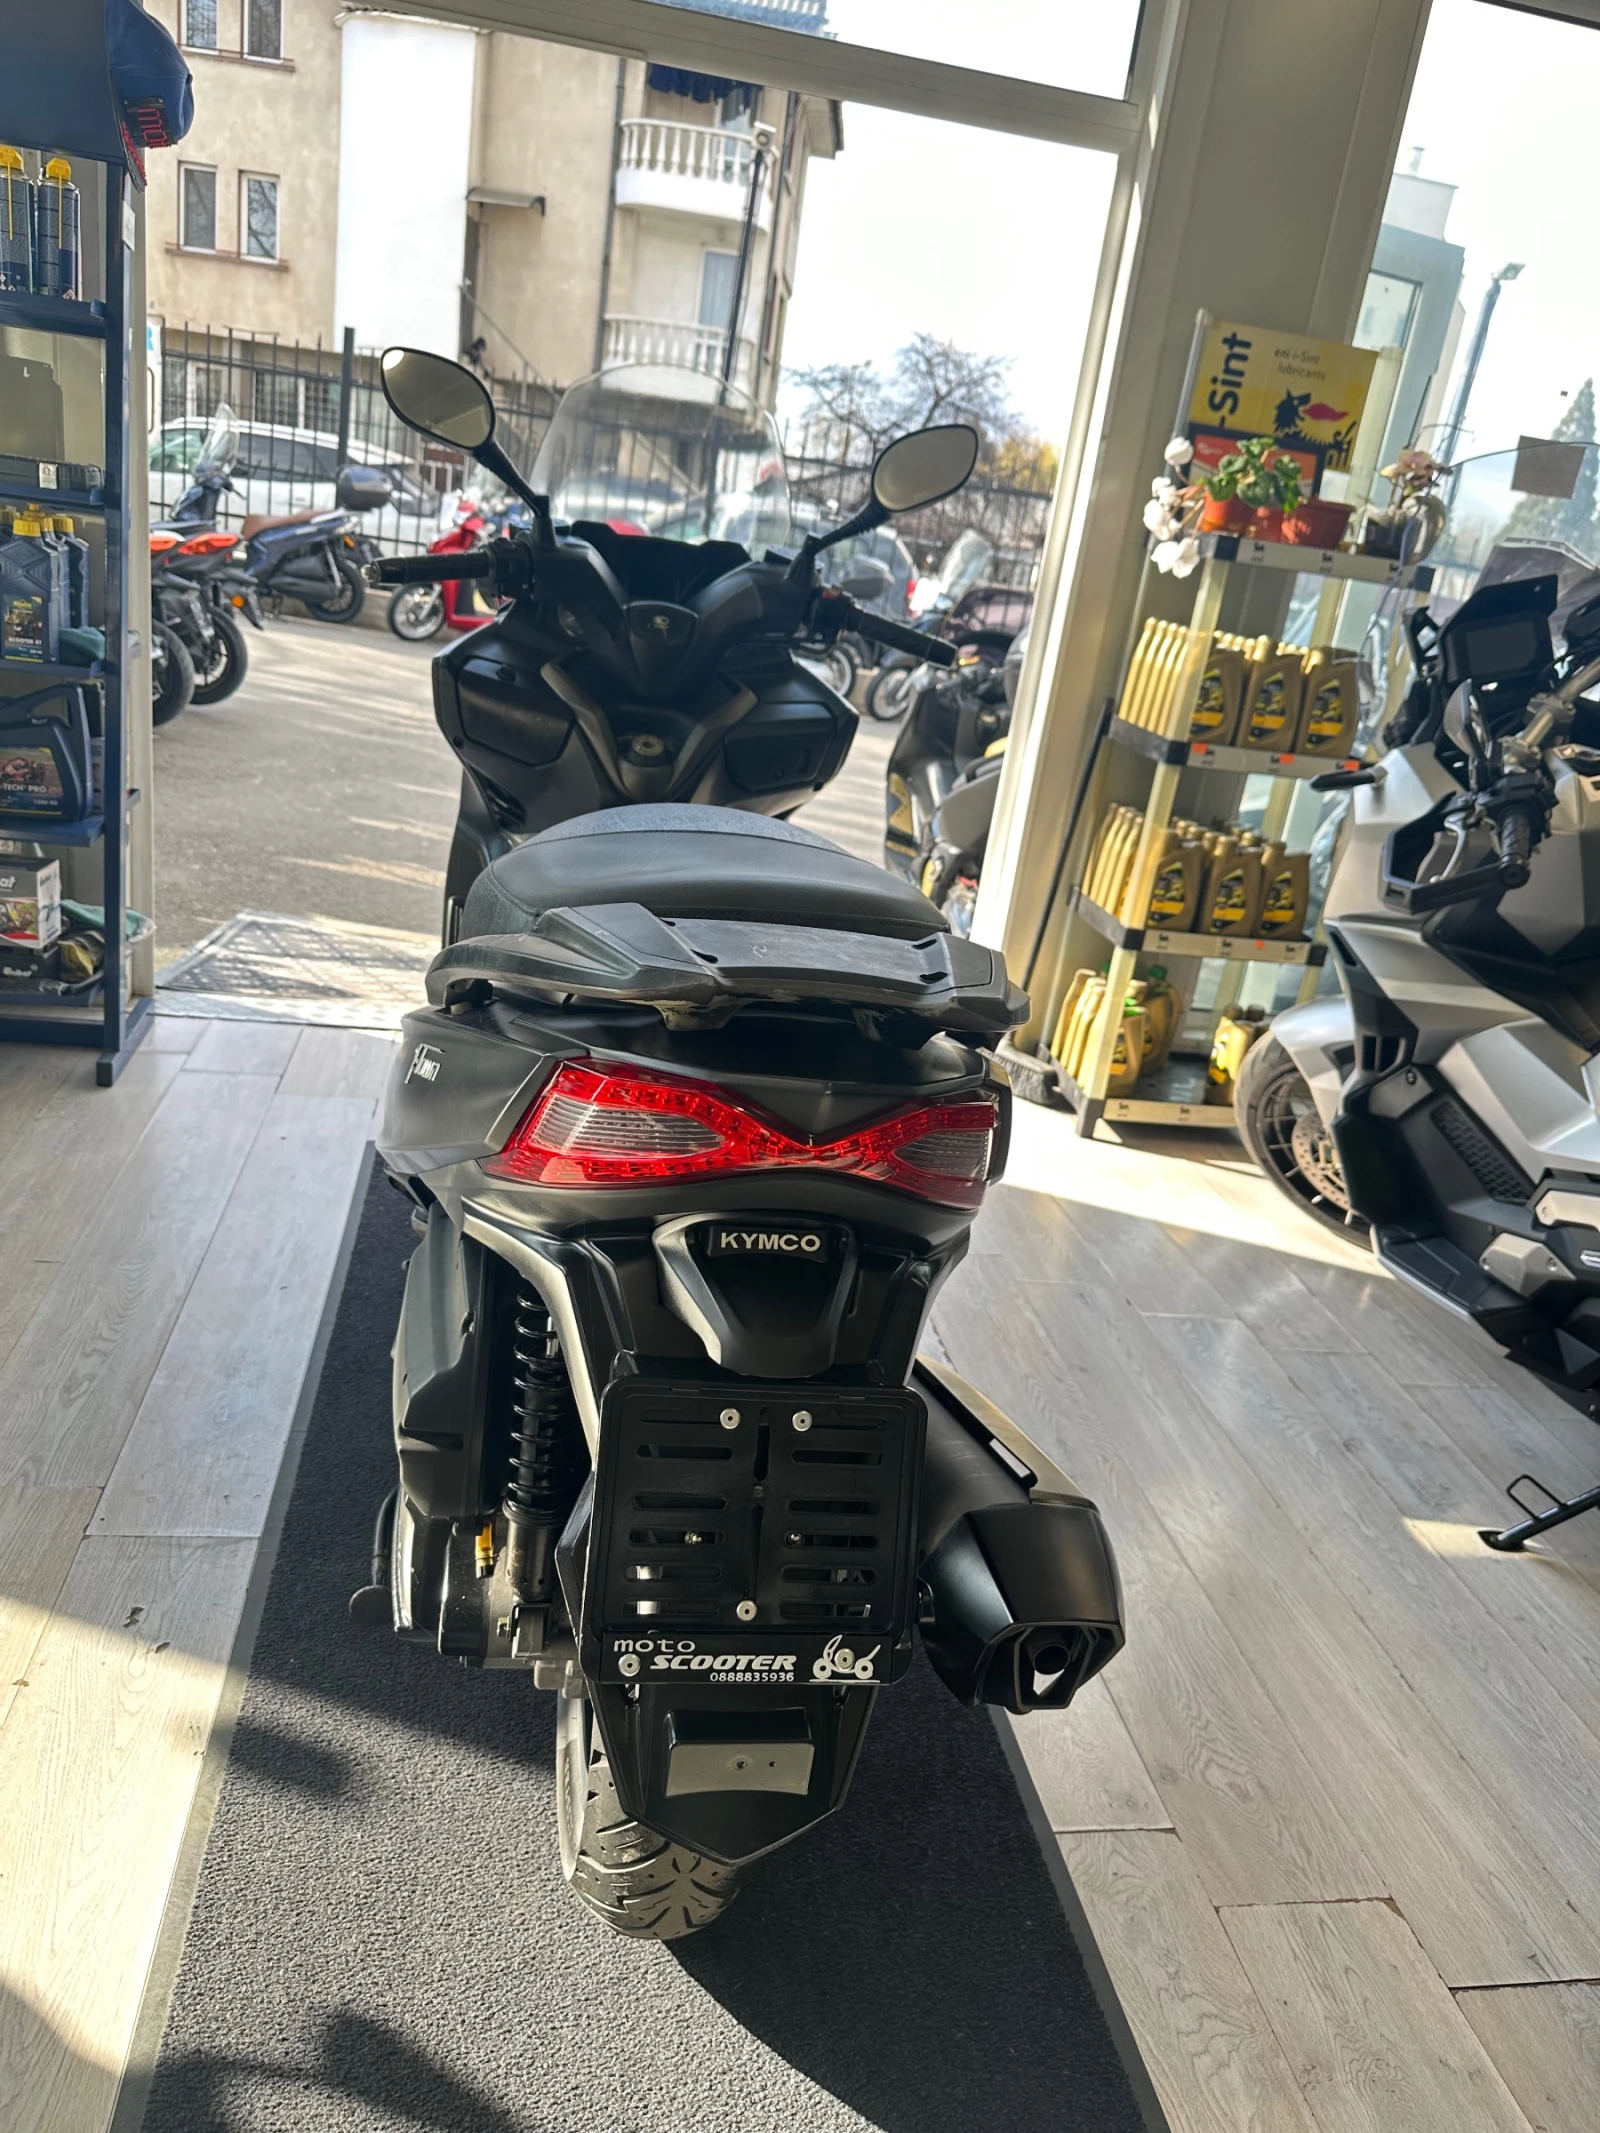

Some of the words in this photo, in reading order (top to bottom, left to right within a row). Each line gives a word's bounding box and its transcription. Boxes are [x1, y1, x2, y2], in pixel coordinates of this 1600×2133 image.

[1277, 363, 1327, 382] lubricants
[721, 1232, 821, 1252] KYMCO
[614, 1639, 696, 1652] moto
[650, 1654, 797, 1670] SCOOTER
[710, 1671, 794, 1682] 0888835936
